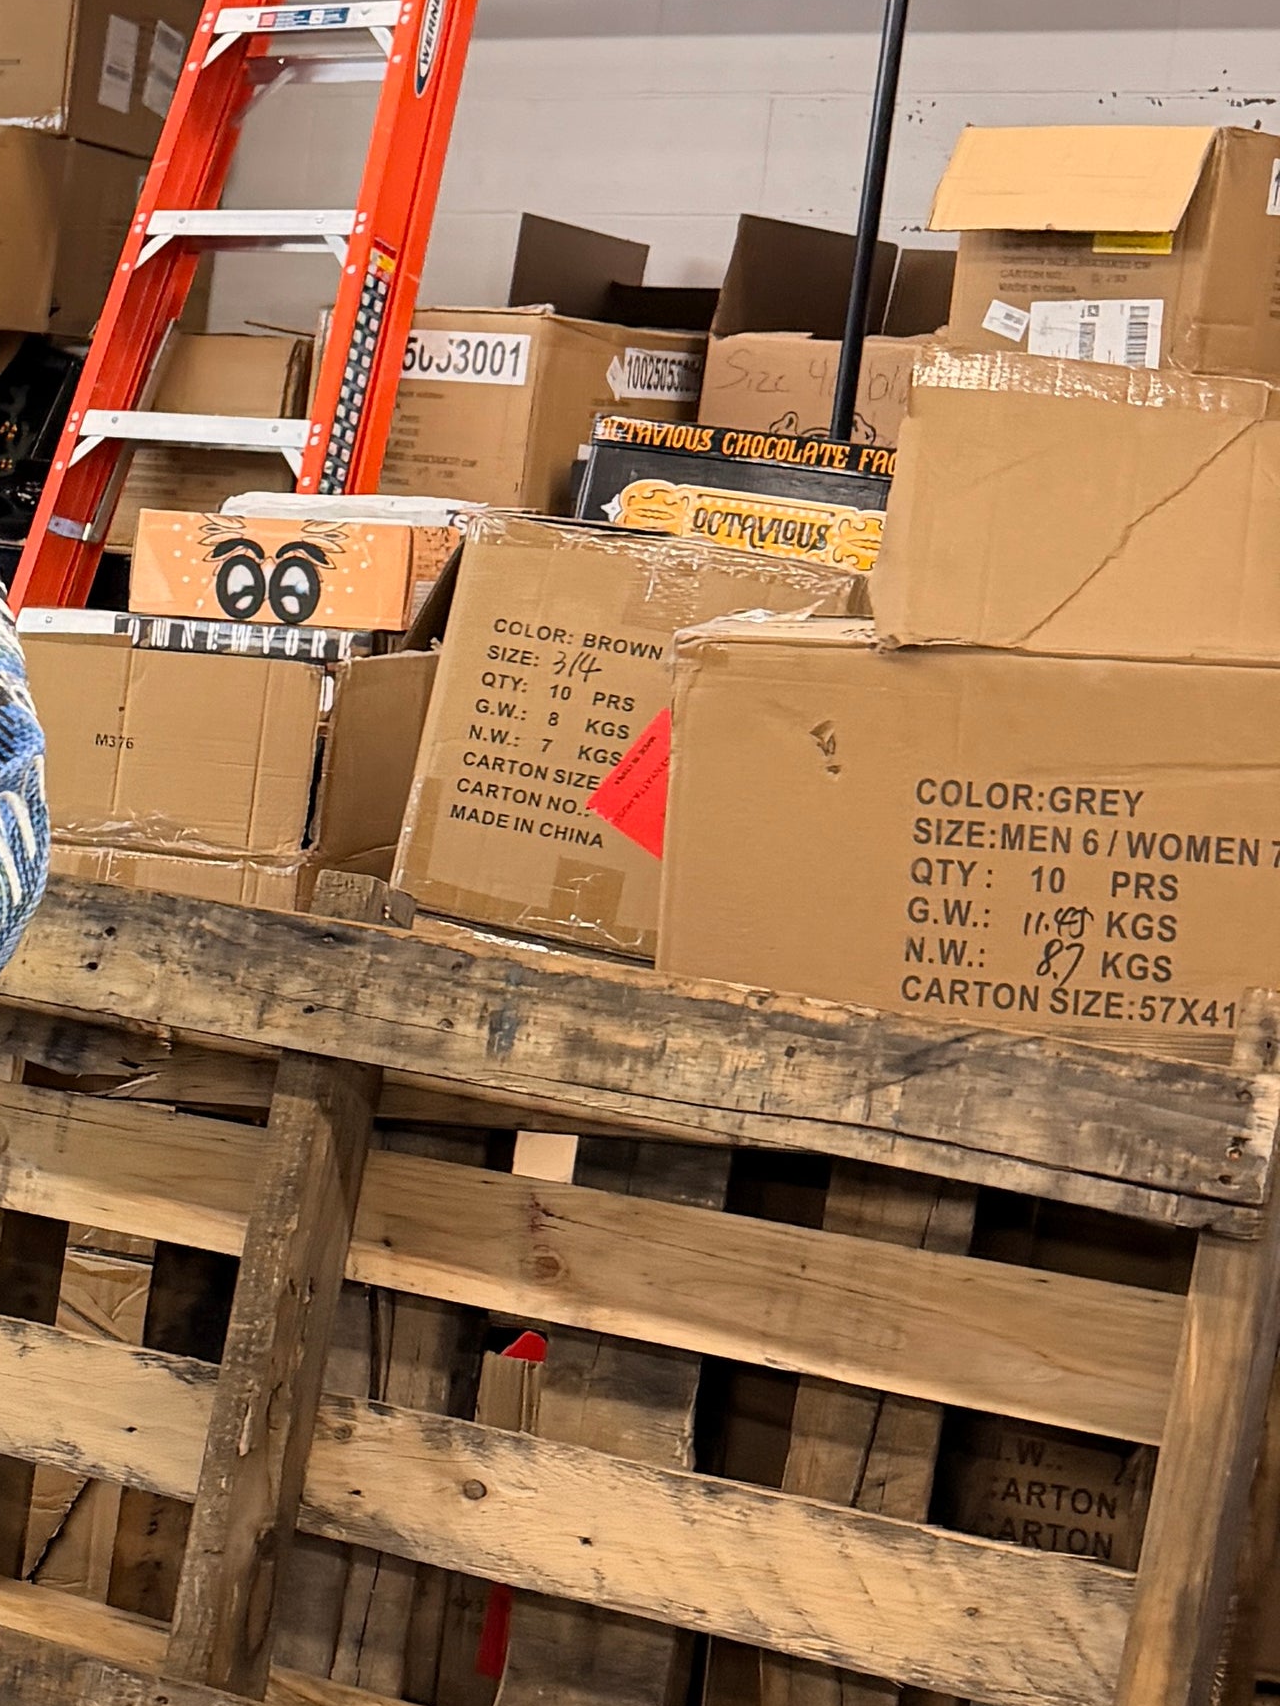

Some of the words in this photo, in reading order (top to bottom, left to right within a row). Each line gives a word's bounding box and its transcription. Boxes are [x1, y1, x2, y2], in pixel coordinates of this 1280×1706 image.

[600, 416, 714, 453] OCTAVIOUS
[721, 431, 850, 470] CHOCOLATE
[692, 506, 833, 553] OCTAVIOUS
[487, 645, 540, 667] SIZE:
[493, 618, 574, 645] COLOR:
[582, 633, 664, 661] BROWN
[481, 671, 528, 693] QTY:
[549, 684, 572, 701] 10
[592, 691, 636, 712] PRS
[475, 698, 527, 721] G.W.:
[547, 712, 560, 726] 8
[584, 718, 630, 740] KGS
[95, 733, 135, 750] M376
[468, 724, 521, 748] N.W.:
[541, 738, 553, 753] 7
[577, 745, 623, 767] KGS
[462, 751, 549, 781] CARTON
[553, 768, 602, 791] SIZE
[456, 778, 542, 808] CARTON
[915, 778, 1144, 818] COLOR:GREY
[449, 804, 510, 829] MADE
[513, 816, 535, 834] IN
[539, 822, 604, 849] CHINA
[913, 817, 1072, 855] SIZE:MEN
[1082, 828, 1100, 857] 6
[1107, 829, 1118, 858] /
[1126, 831, 1261, 868] WOMEN
[1030, 865, 1066, 894] 10
[1110, 870, 1180, 902] PRS
[907, 896, 991, 928] G.W.:
[1105, 910, 1178, 943] KGS
[904, 937, 985, 969] N.W.:
[1101, 950, 1173, 984] KGS
[901, 975, 1040, 1014] CARTON
[989, 1476, 1118, 1520] ARTON
[986, 1513, 1114, 1560] ARTON
